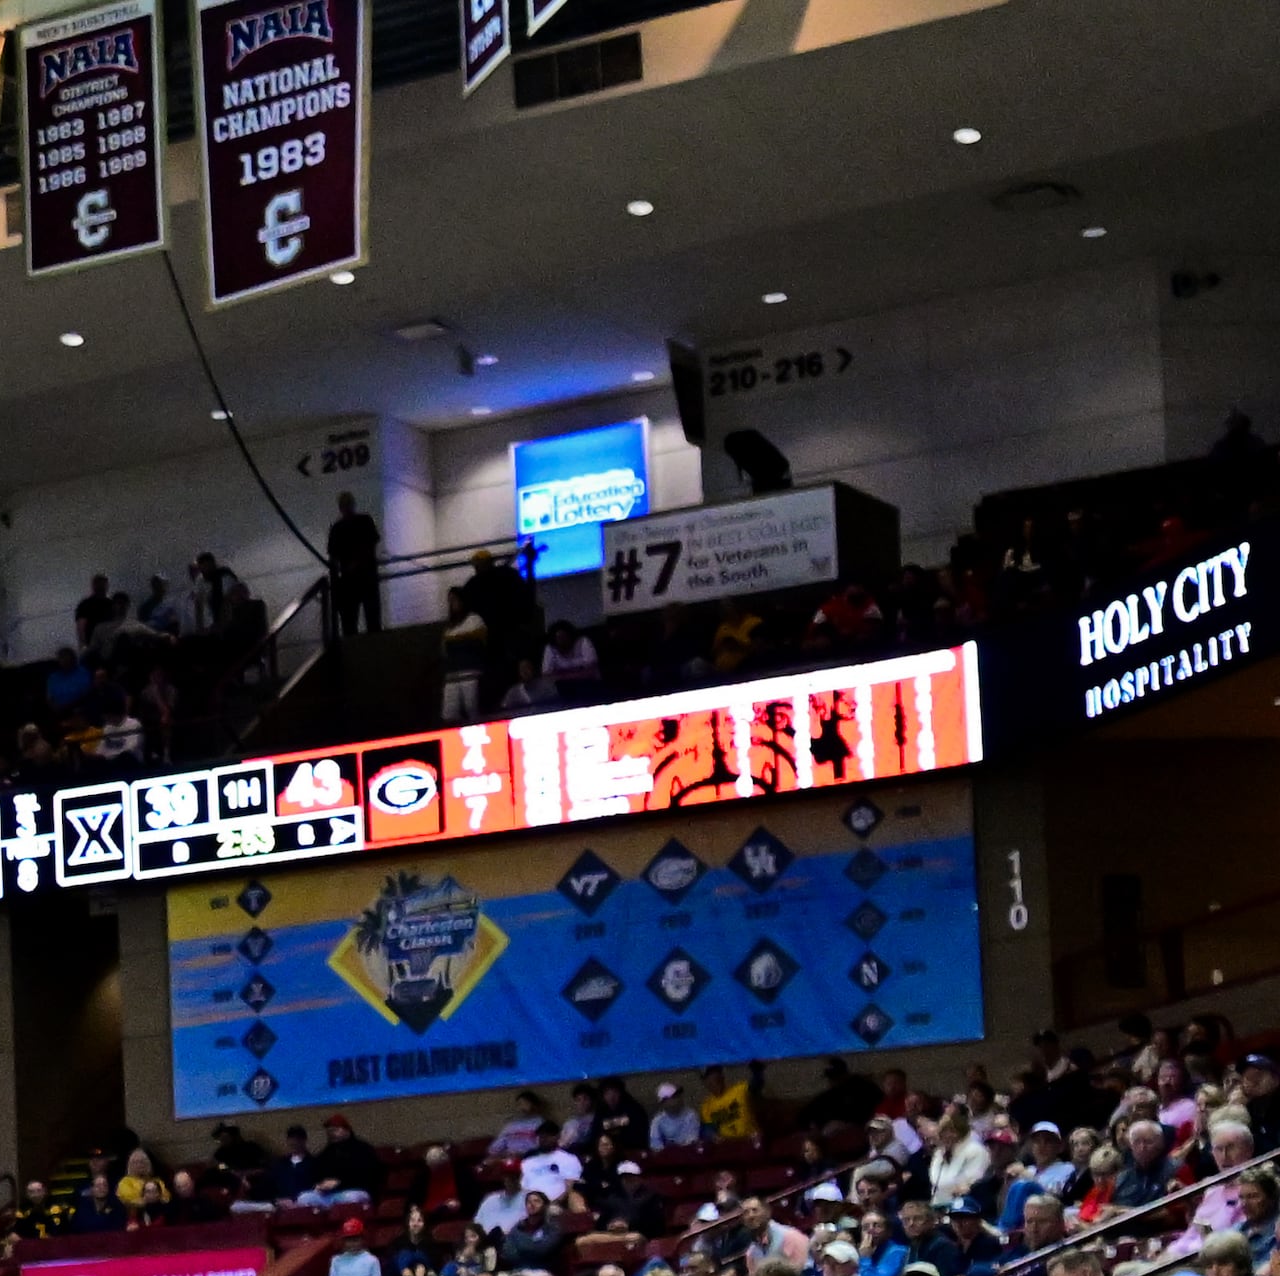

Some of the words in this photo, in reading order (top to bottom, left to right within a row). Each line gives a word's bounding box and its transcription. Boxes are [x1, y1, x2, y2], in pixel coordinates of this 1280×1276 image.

[41, 28, 140, 98] NAIA
[226, 0, 333, 72] NAIA
[221, 53, 341, 110] NATIONAL
[212, 81, 352, 145] CHAMPIONS
[238, 130, 327, 187] 1983
[1078, 581, 1168, 666] HOLY
[1173, 542, 1251, 623] CITY
[1085, 622, 1252, 718] HOSPITALITY
[223, 776, 261, 809] 1H
[286, 759, 343, 808] 43
[465, 796, 487, 829] 7
[388, 916, 475, 940] Charleston
[329, 1054, 380, 1088] PAST
[385, 1041, 519, 1080] CHAMPIONS
